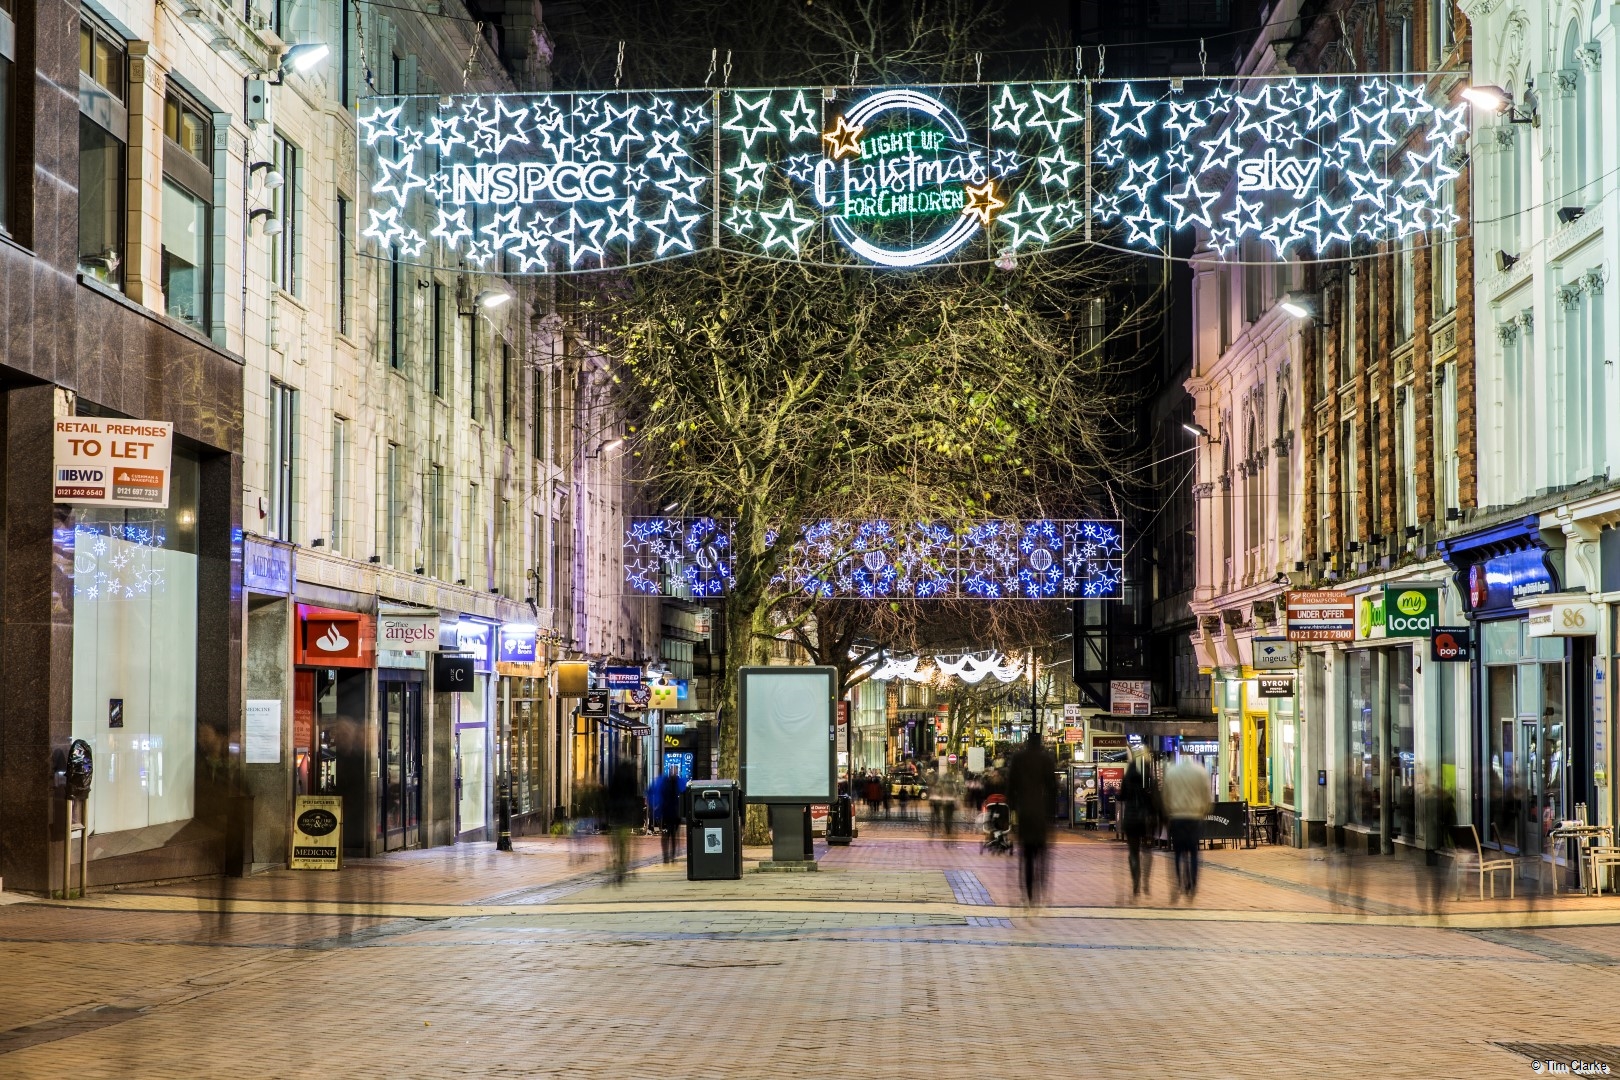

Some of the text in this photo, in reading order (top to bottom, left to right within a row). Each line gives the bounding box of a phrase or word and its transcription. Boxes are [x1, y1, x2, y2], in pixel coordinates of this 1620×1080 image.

[860, 130, 944, 159] LIGHT UP
[814, 150, 986, 206] Christmas
[1237, 147, 1321, 199] sky
[452, 162, 616, 204] NSPCC
[877, 190, 963, 216] CHILDREN
[56, 422, 167, 438] RETAIL PREMISES
[67, 439, 154, 460] TO LET
[69, 469, 104, 482] BWD
[86, 489, 103, 497] 6540
[117, 487, 131, 495] 0121
[144, 488, 159, 497] 7333
[252, 554, 287, 581] MEDICINE
[1402, 597, 1422, 611] my
[1297, 610, 1345, 619] UNDER OFFER
[1388, 613, 1435, 631] local
[1563, 608, 1585, 627] 86
[385, 624, 435, 643] angels
[1290, 630, 1352, 639] 0121 212 7800
[1262, 655, 1287, 663] ingeus
[1440, 647, 1466, 657] pop in
[1182, 743, 1219, 754] wagama
[295, 848, 335, 856] MEDICINE
